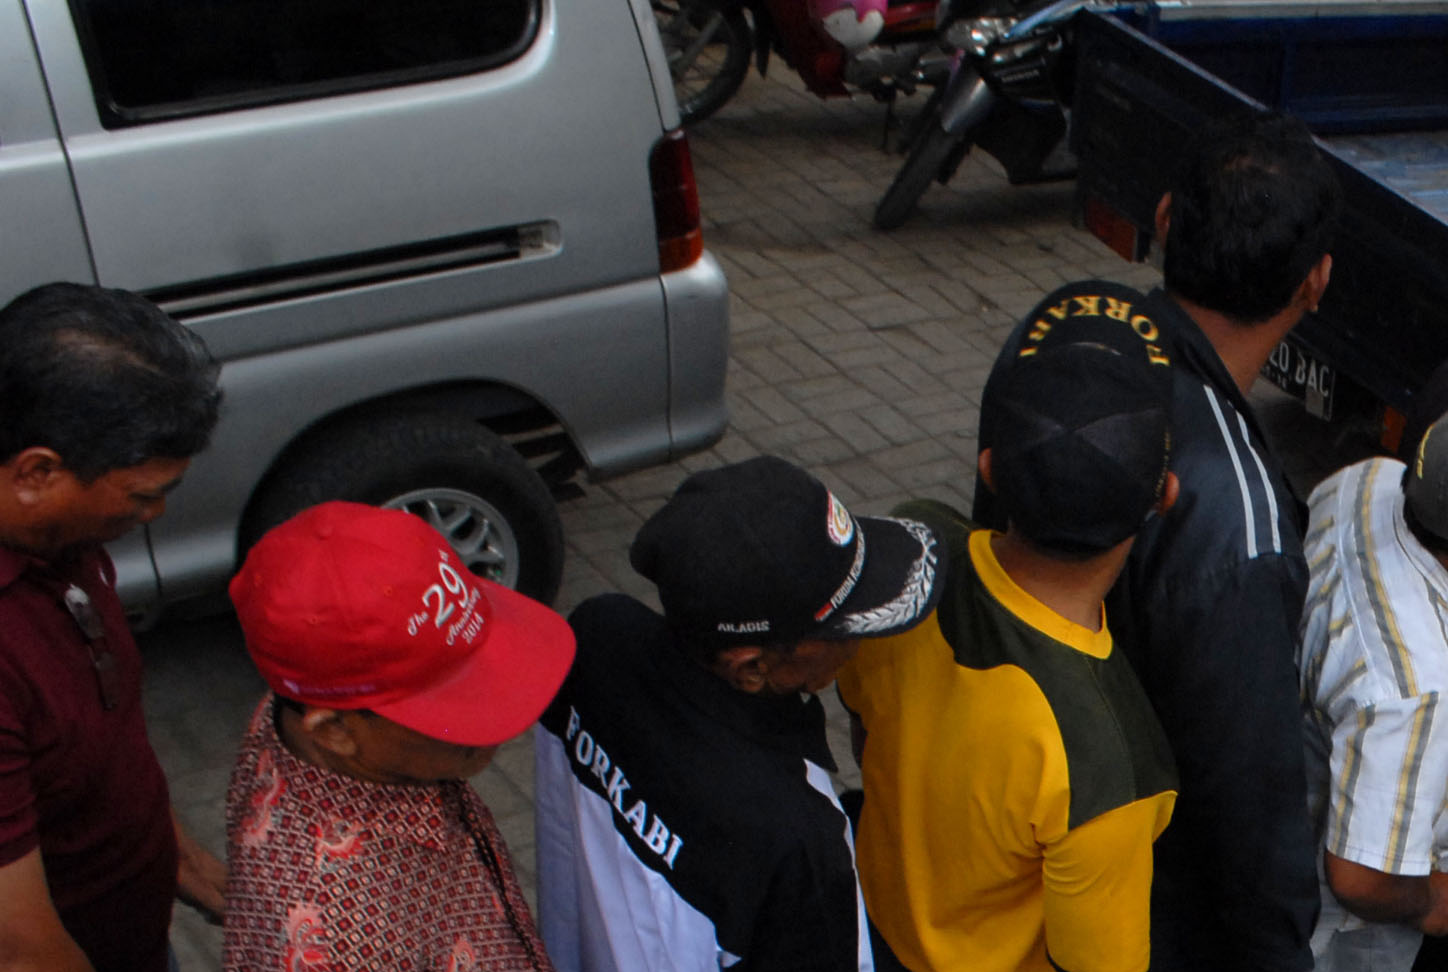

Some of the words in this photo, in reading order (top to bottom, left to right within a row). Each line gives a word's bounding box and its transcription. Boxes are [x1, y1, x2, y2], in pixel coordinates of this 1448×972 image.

[1018, 294, 1172, 367] FORKABI
[461, 611, 485, 645] 2014
[566, 705, 685, 871] FORKABI
